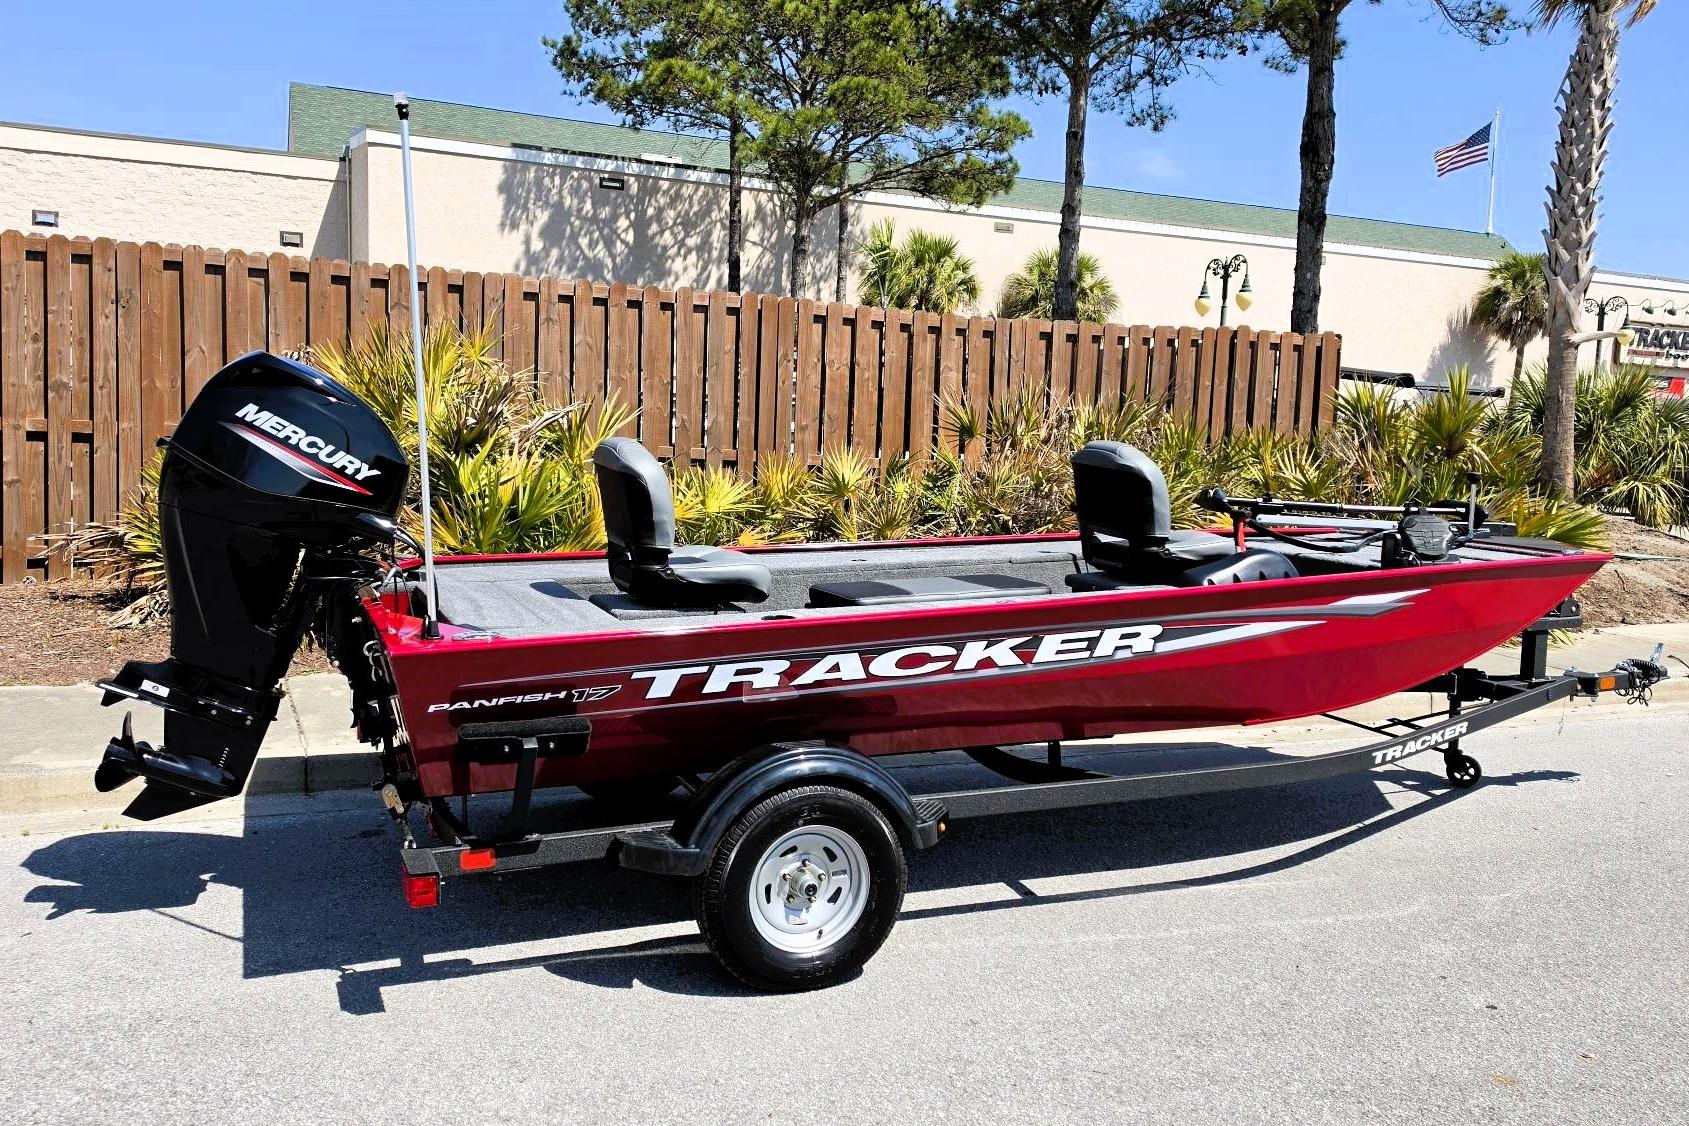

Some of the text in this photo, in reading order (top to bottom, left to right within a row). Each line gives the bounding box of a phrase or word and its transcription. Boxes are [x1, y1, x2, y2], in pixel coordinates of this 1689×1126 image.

[234, 402, 382, 481] MERCURY
[629, 624, 1164, 700] TRACKER
[427, 684, 622, 713] PANFISH 17
[1372, 721, 1469, 765] TRACKER
